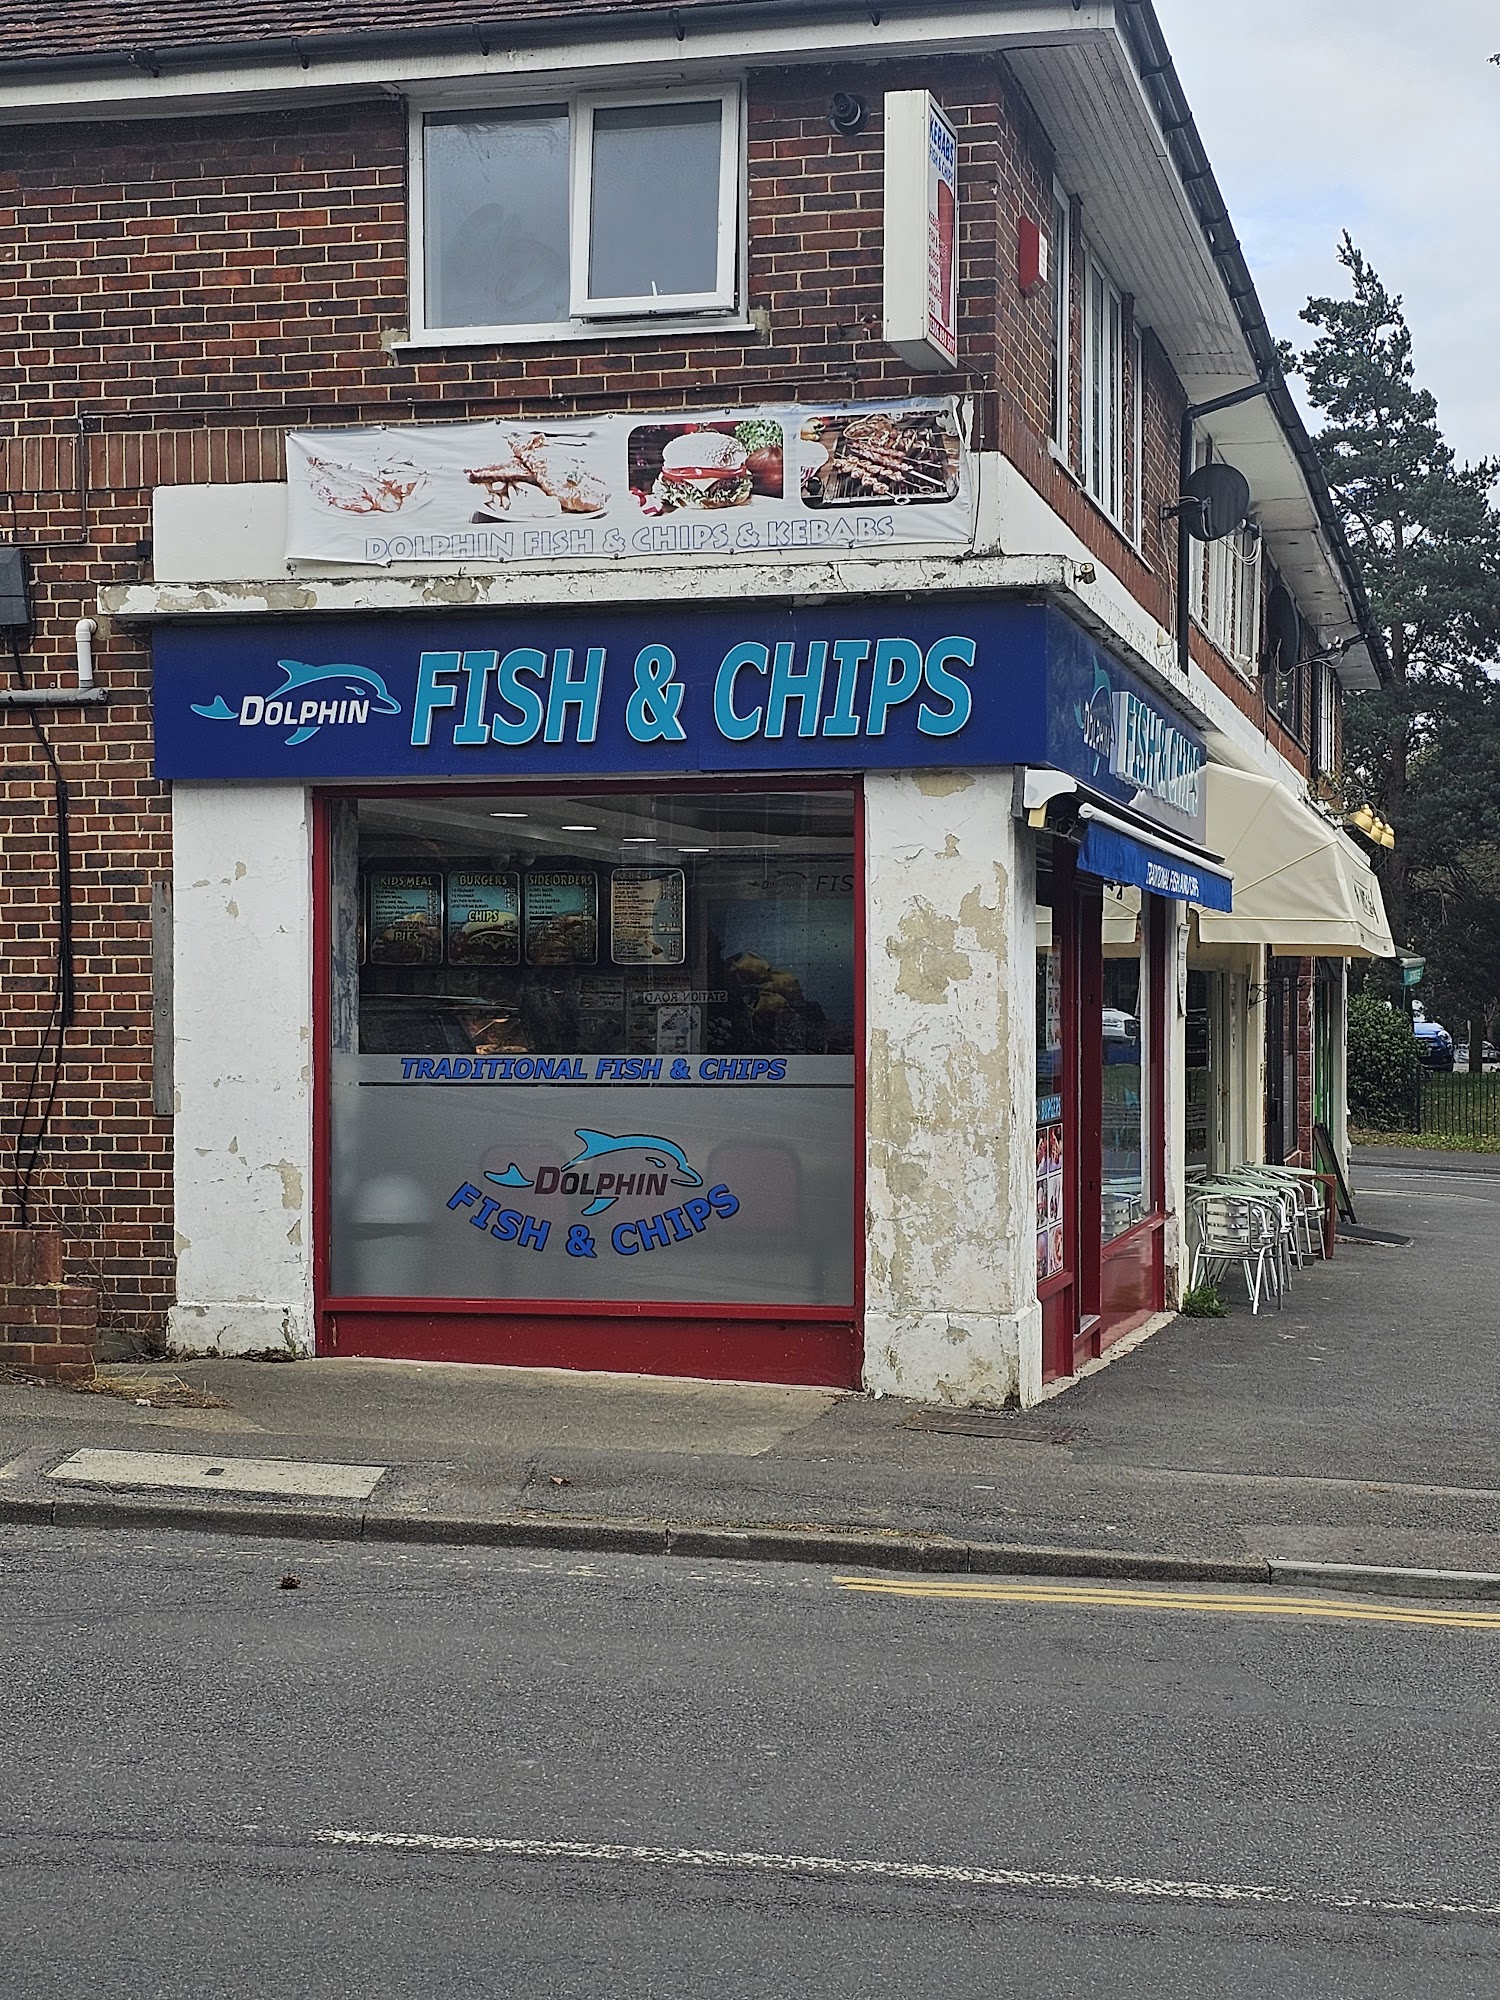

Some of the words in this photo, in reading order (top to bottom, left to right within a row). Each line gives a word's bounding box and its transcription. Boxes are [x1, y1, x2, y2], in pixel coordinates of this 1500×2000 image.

[929, 115, 954, 166] KEBABS
[941, 161, 953, 187] CHIPS
[366, 532, 514, 561] DOLPHIN
[523, 529, 594, 555] FISH
[602, 528, 626, 553] &
[632, 523, 730, 552] CHIPS
[735, 522, 759, 548] &
[767, 516, 895, 547] KEBABS
[410, 647, 607, 746] FISH
[626, 643, 687, 742] &
[713, 635, 978, 742] CHIPS
[1113, 692, 1157, 789] FISH
[1166, 727, 1200, 818] CHIPS
[380, 876, 405, 886] KIDS
[406, 876, 433, 886] MEAL
[459, 875, 508, 886] BURGERS
[529, 875, 551, 886] SIDE
[552, 874, 593, 886] ORDERS
[468, 910, 499, 922] CHIPS
[394, 930, 419, 941] PIES
[400, 1058, 587, 1080] TRADITIONAL
[595, 1058, 663, 1080] FISH
[669, 1058, 691, 1080] &
[699, 1058, 787, 1080] CHIPS
[446, 1182, 552, 1252] FISH
[566, 1225, 597, 1258] &
[611, 1184, 740, 1255] CHIPS
